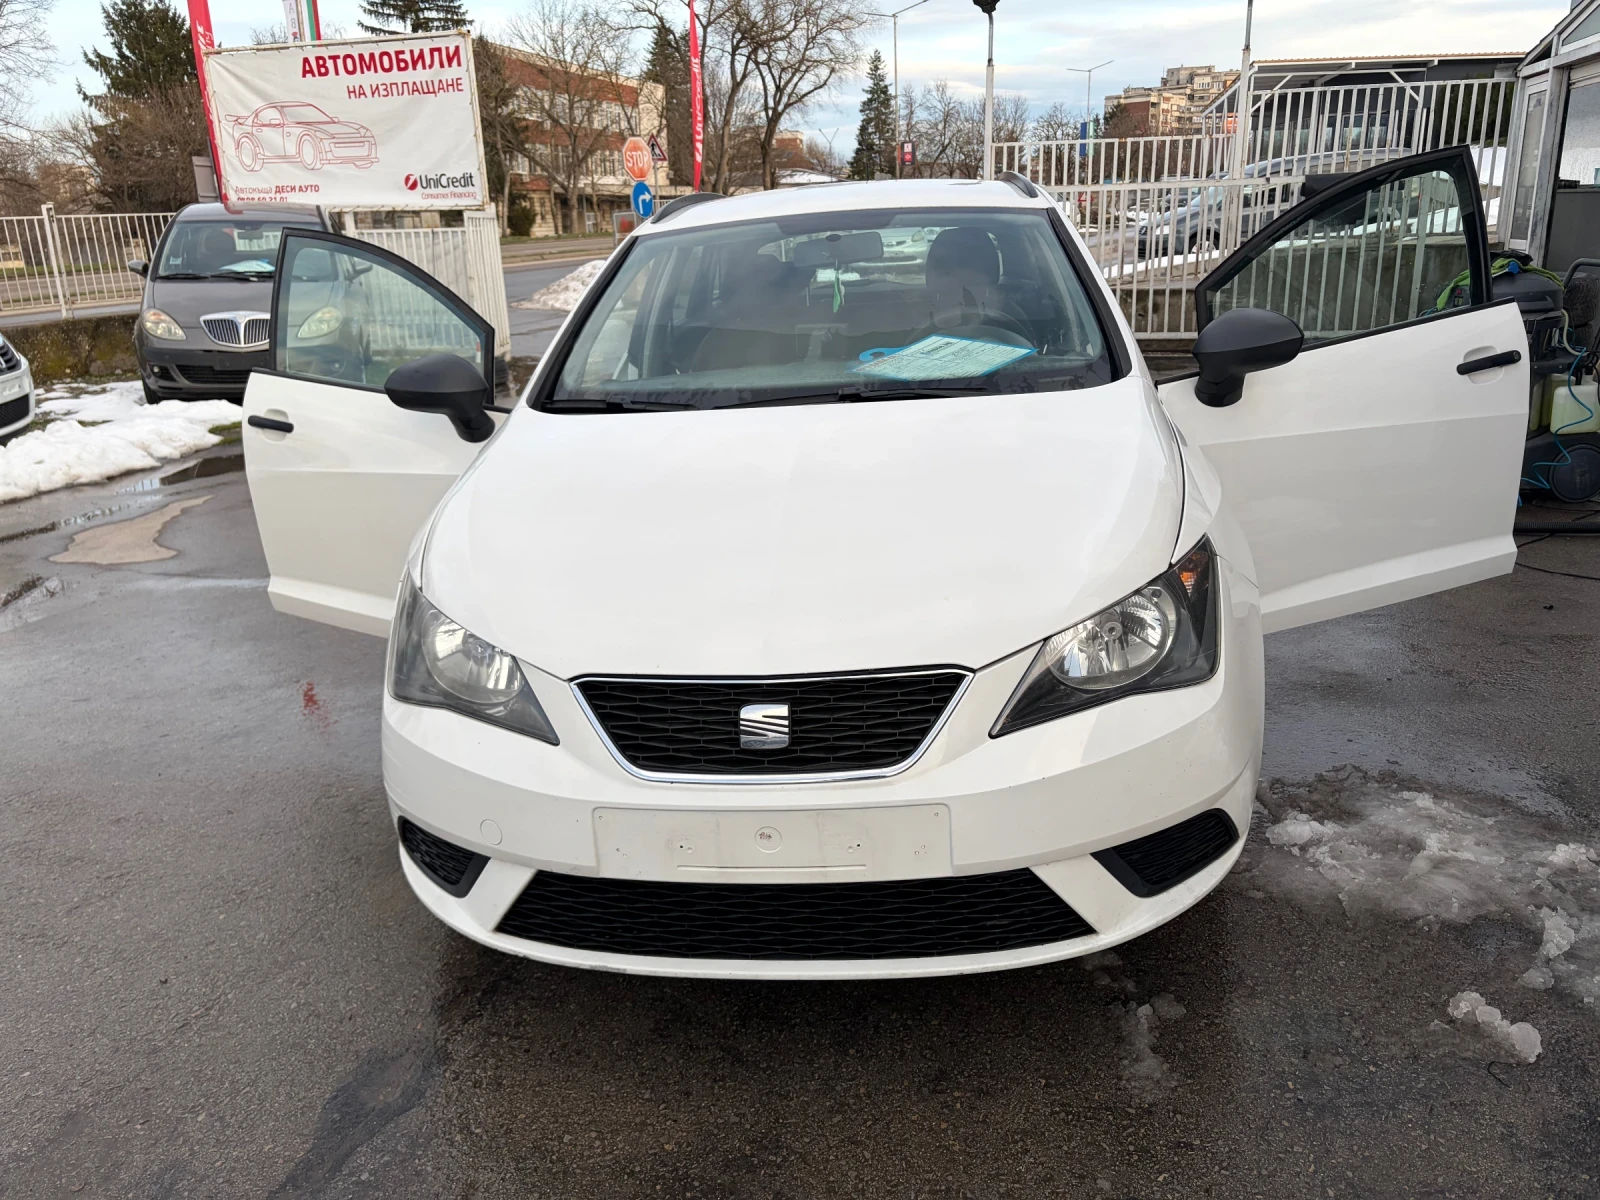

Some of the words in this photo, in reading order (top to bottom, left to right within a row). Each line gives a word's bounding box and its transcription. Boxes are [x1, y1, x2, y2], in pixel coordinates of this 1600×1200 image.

[301, 45, 462, 78] АВТОМОБИЛИ
[346, 84, 368, 100] НА
[370, 77, 464, 98] ИЗПЛАЩАНЕ
[626, 151, 649, 167] STOP
[419, 172, 475, 189] UniCredit
[275, 184, 297, 195] ДЕСИ
[298, 184, 320, 193] АУТО
